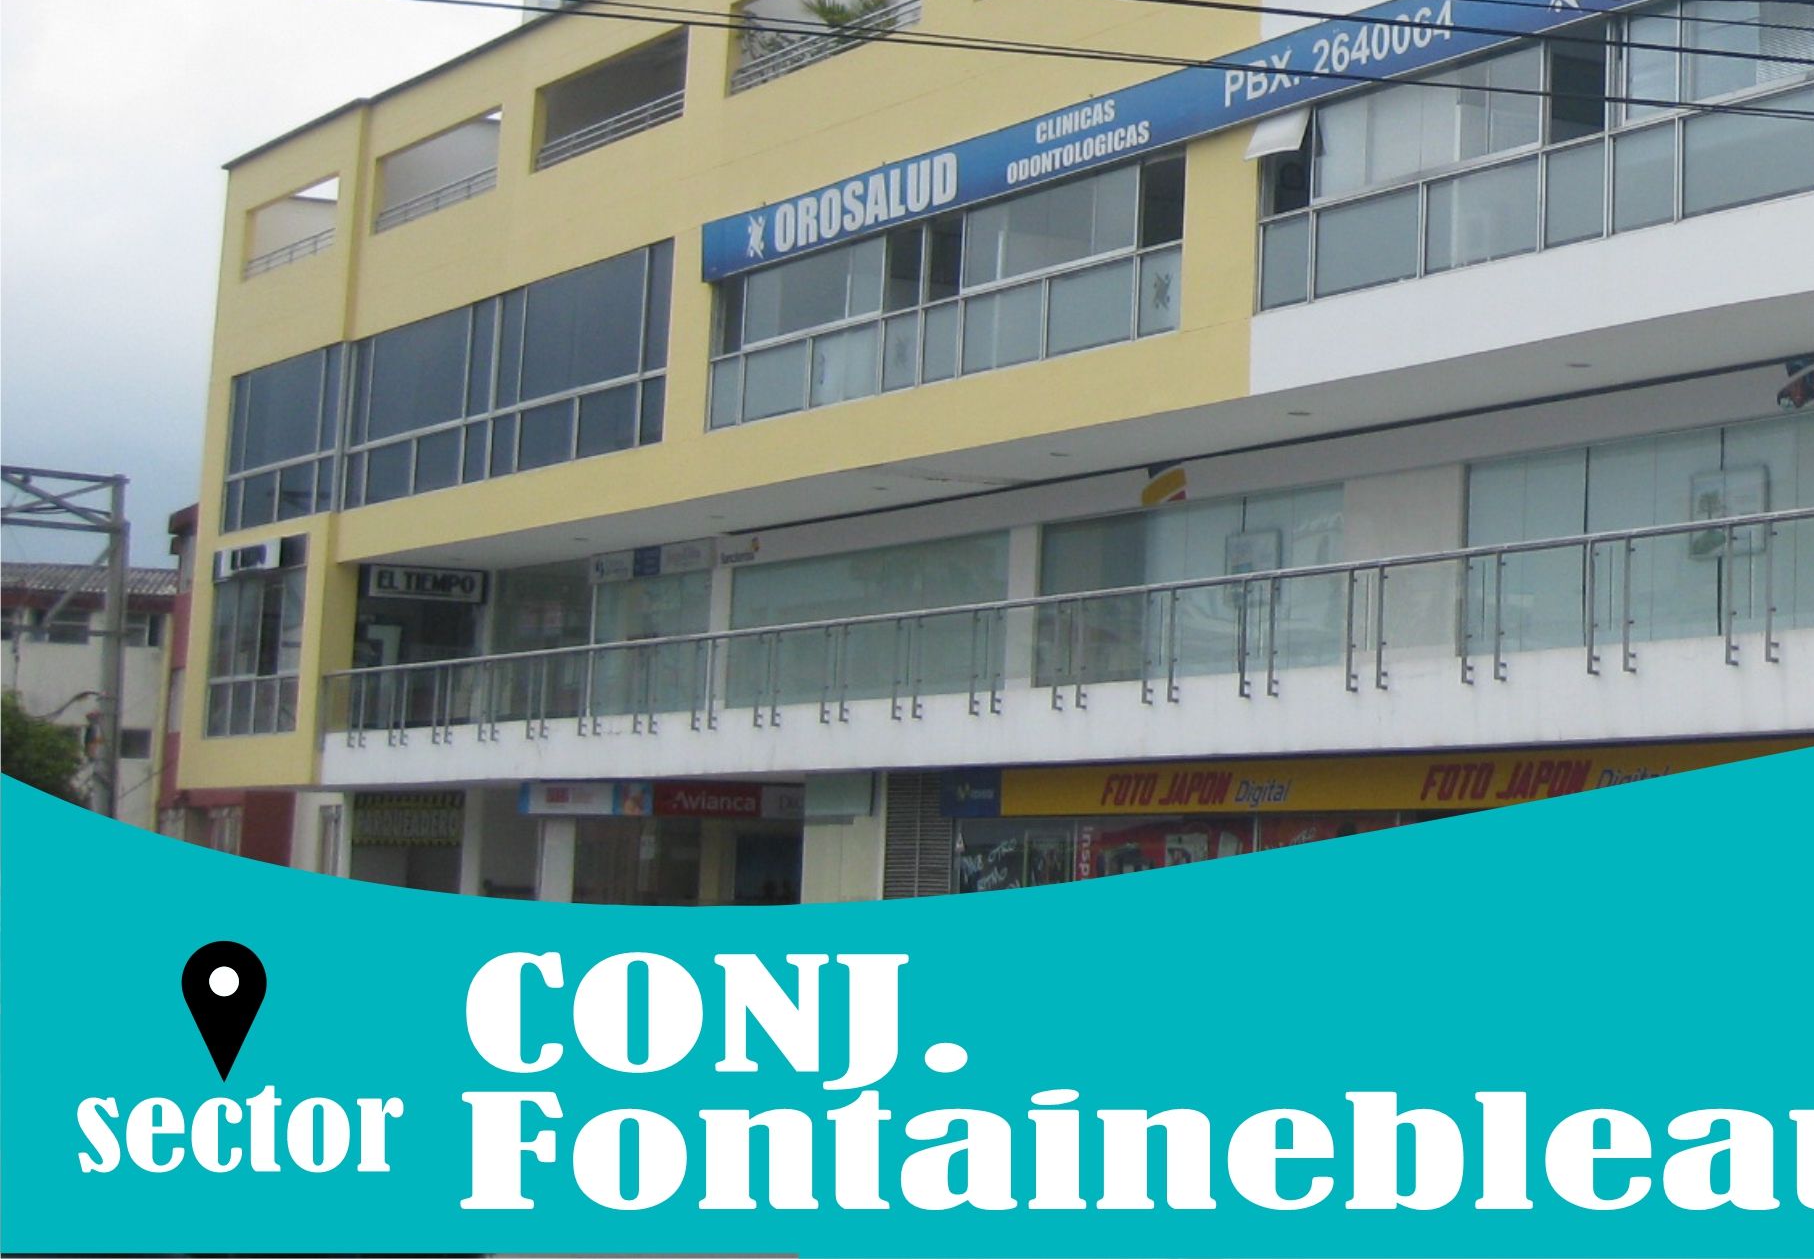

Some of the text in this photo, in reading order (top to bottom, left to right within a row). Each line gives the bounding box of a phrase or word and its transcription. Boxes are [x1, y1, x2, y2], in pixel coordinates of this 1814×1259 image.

[1224, 0, 1454, 108] PBX. 2640064
[1035, 99, 1115, 144] CLINICAS
[1006, 120, 1151, 185] ODONTOLOGICAS
[774, 152, 958, 252] OROSALUD
[378, 570, 475, 594] EL TIEMPO
[672, 791, 756, 812] Avianca
[1101, 771, 1291, 807] FOTO JAPON Digital
[1420, 762, 1495, 801] FOTO
[1496, 760, 1593, 800] JAPON
